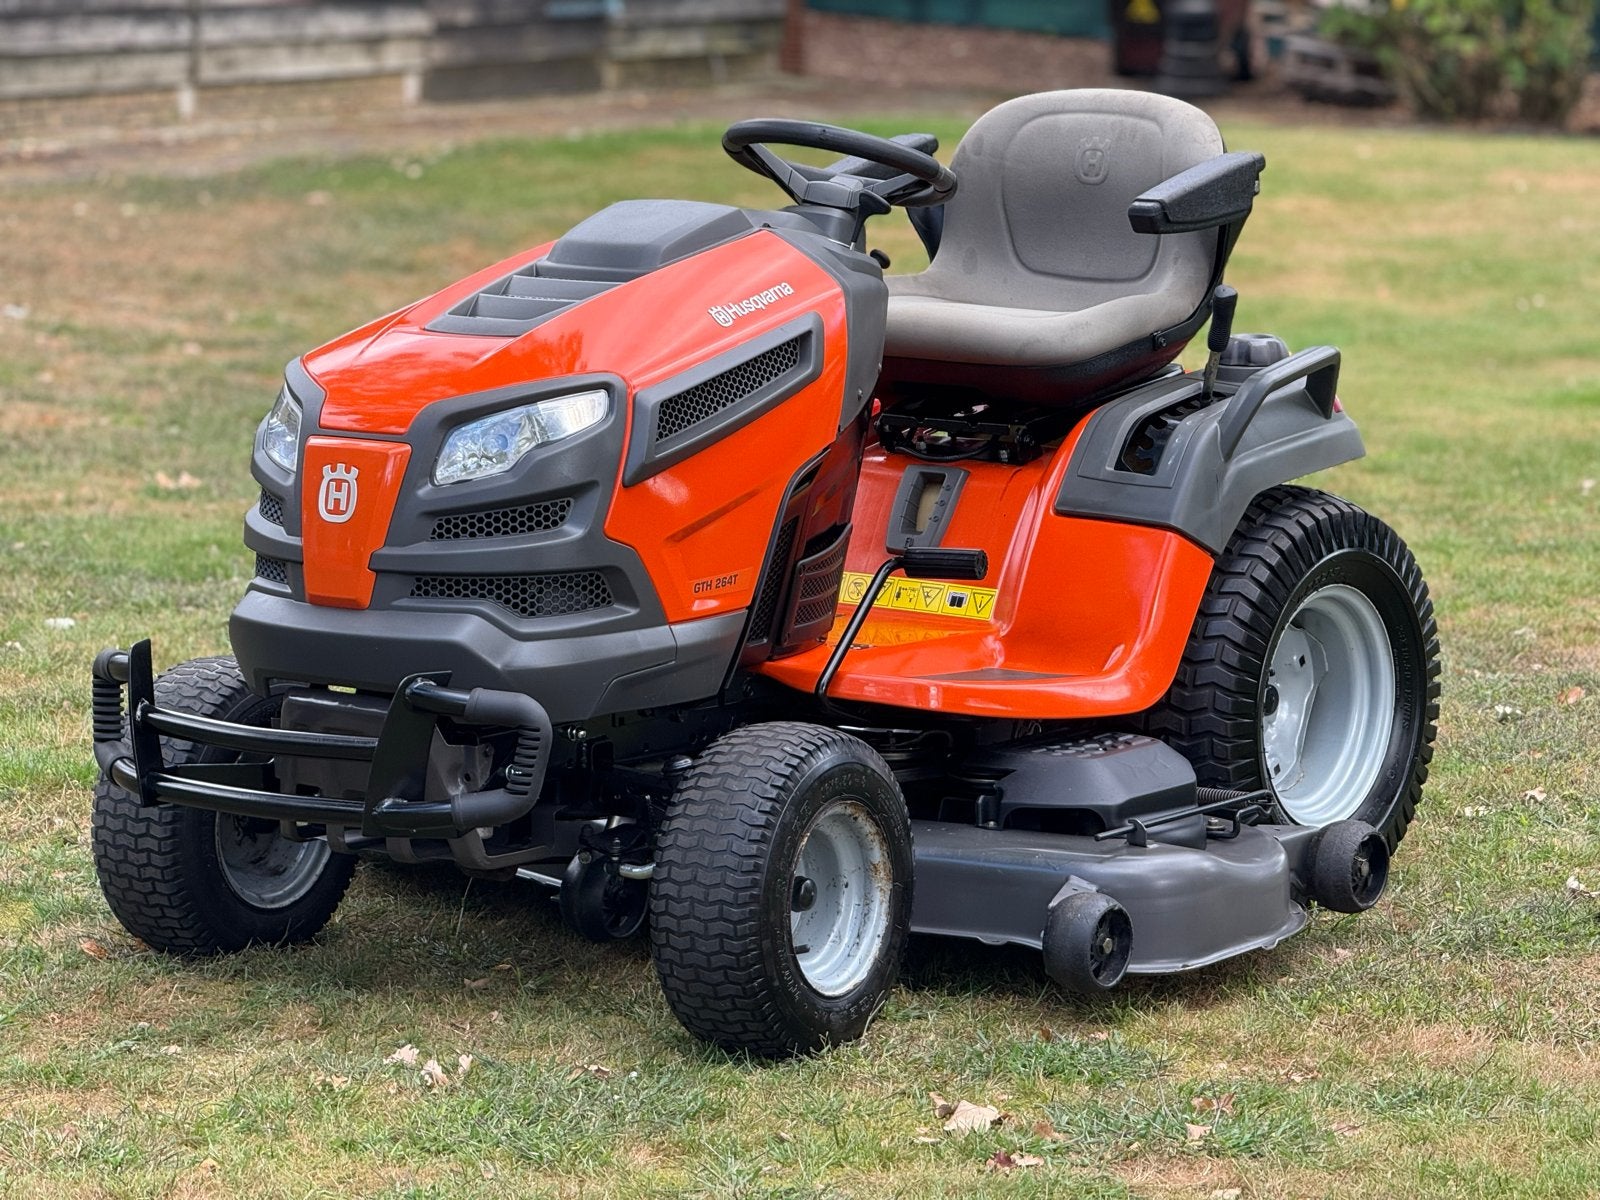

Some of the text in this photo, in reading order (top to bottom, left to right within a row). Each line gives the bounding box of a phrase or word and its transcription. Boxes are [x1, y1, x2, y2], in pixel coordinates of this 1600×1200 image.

[722, 282, 795, 319] Husqvarna
[693, 574, 738, 593] GTH 264T
